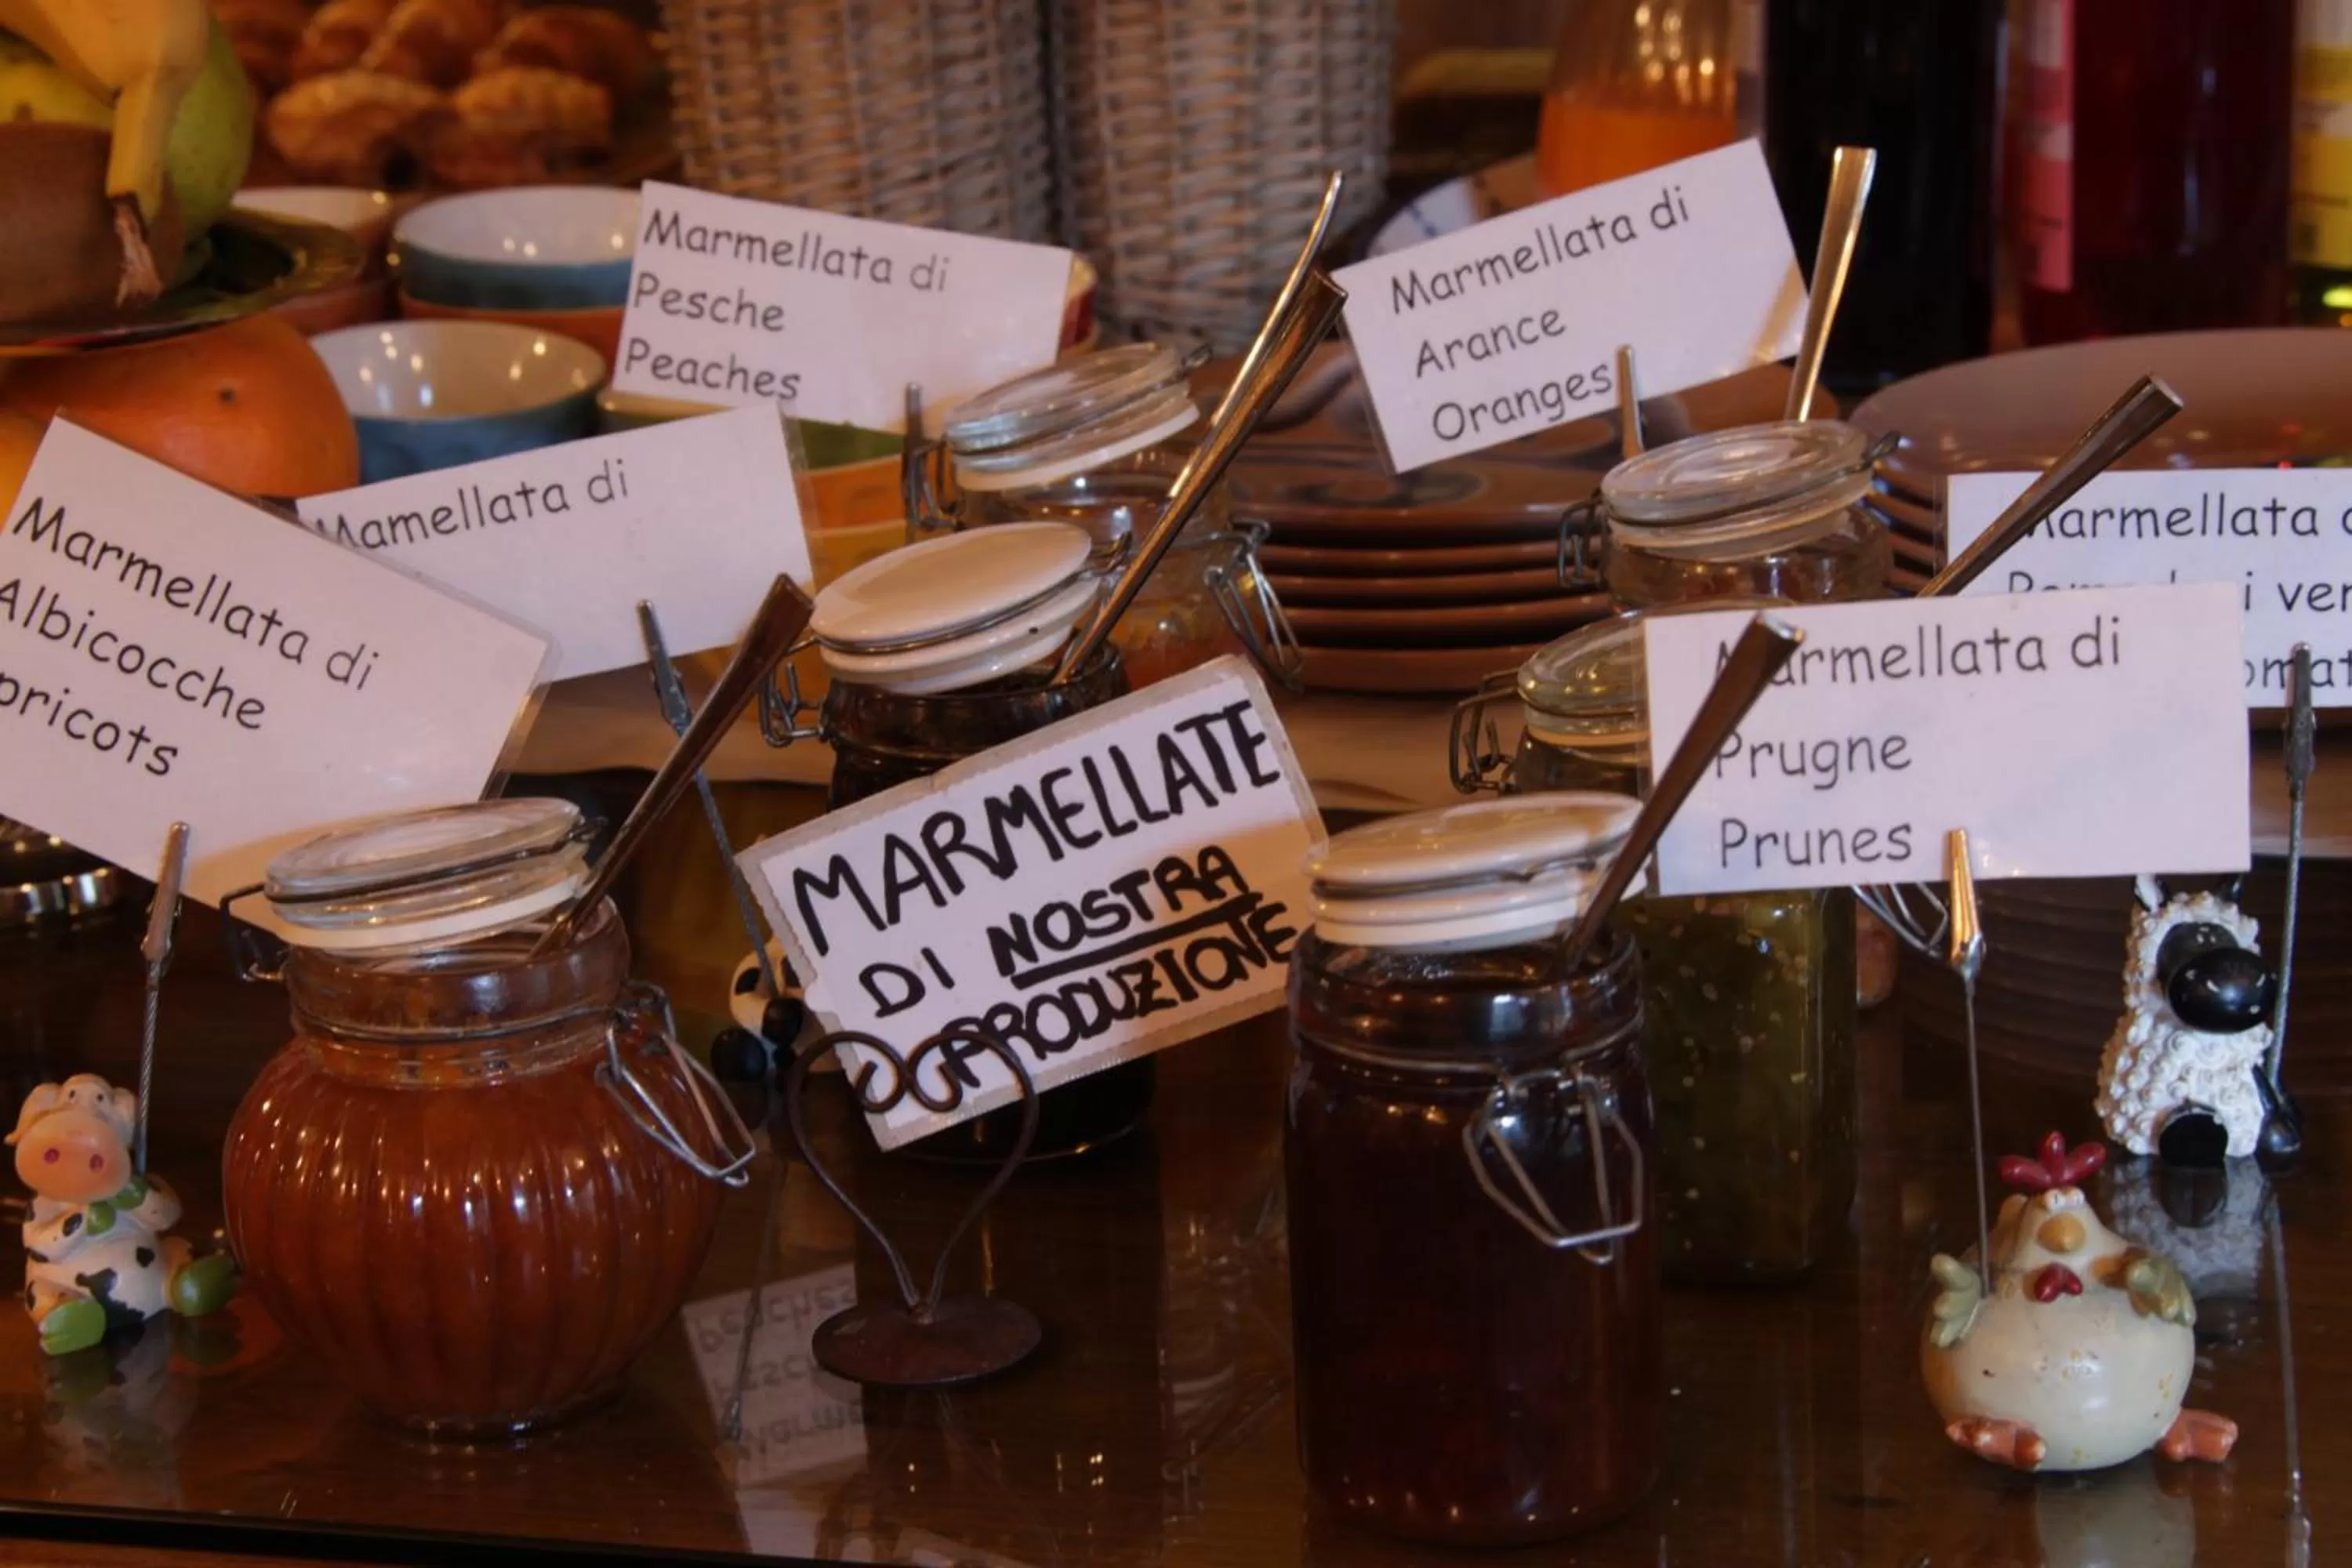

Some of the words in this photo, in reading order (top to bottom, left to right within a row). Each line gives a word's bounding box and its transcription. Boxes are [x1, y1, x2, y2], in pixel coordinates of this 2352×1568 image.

[643, 209, 892, 284] Marmellata
[909, 255, 949, 292] di
[1391, 214, 1638, 314] Marmellata
[1650, 185, 1689, 230] di
[633, 271, 785, 332] Pesche
[624, 338, 800, 401] Peaches
[1416, 309, 1566, 378] Arance
[1432, 363, 1613, 442] Oranges
[586, 458, 628, 504] di
[12, 497, 309, 664] Marmellata
[327, 644, 379, 691] di
[0, 579, 265, 730] Albicocche
[2071, 615, 2120, 669] di
[1716, 730, 1911, 791] Prugne
[792, 699, 1281, 957] MARMELLATE
[1721, 817, 1912, 869] Prunes
[858, 947, 955, 1018] DI
[986, 844, 1250, 977] NOSTRA
[940, 902, 1298, 1088] PRODUZIONE
